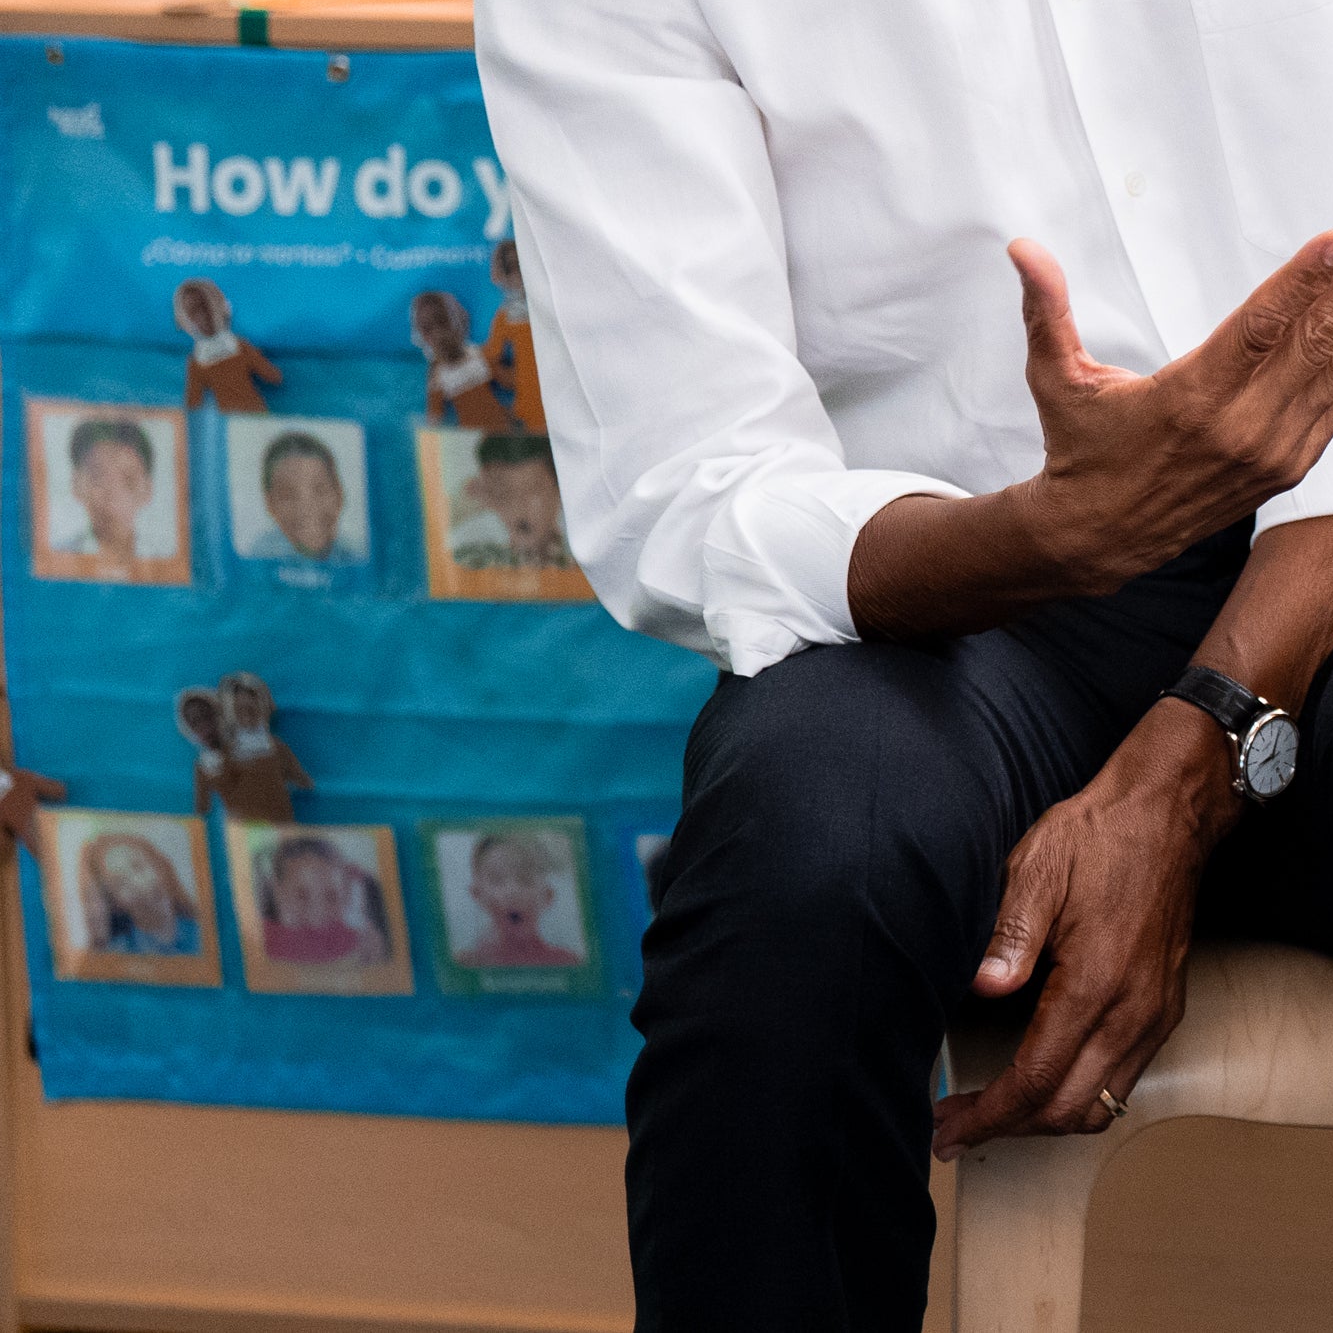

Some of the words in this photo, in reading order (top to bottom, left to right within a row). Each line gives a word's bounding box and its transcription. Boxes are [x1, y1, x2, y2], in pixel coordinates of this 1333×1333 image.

[153, 141, 340, 216] How
[354, 143, 463, 218] do
[473, 157, 513, 239] y
